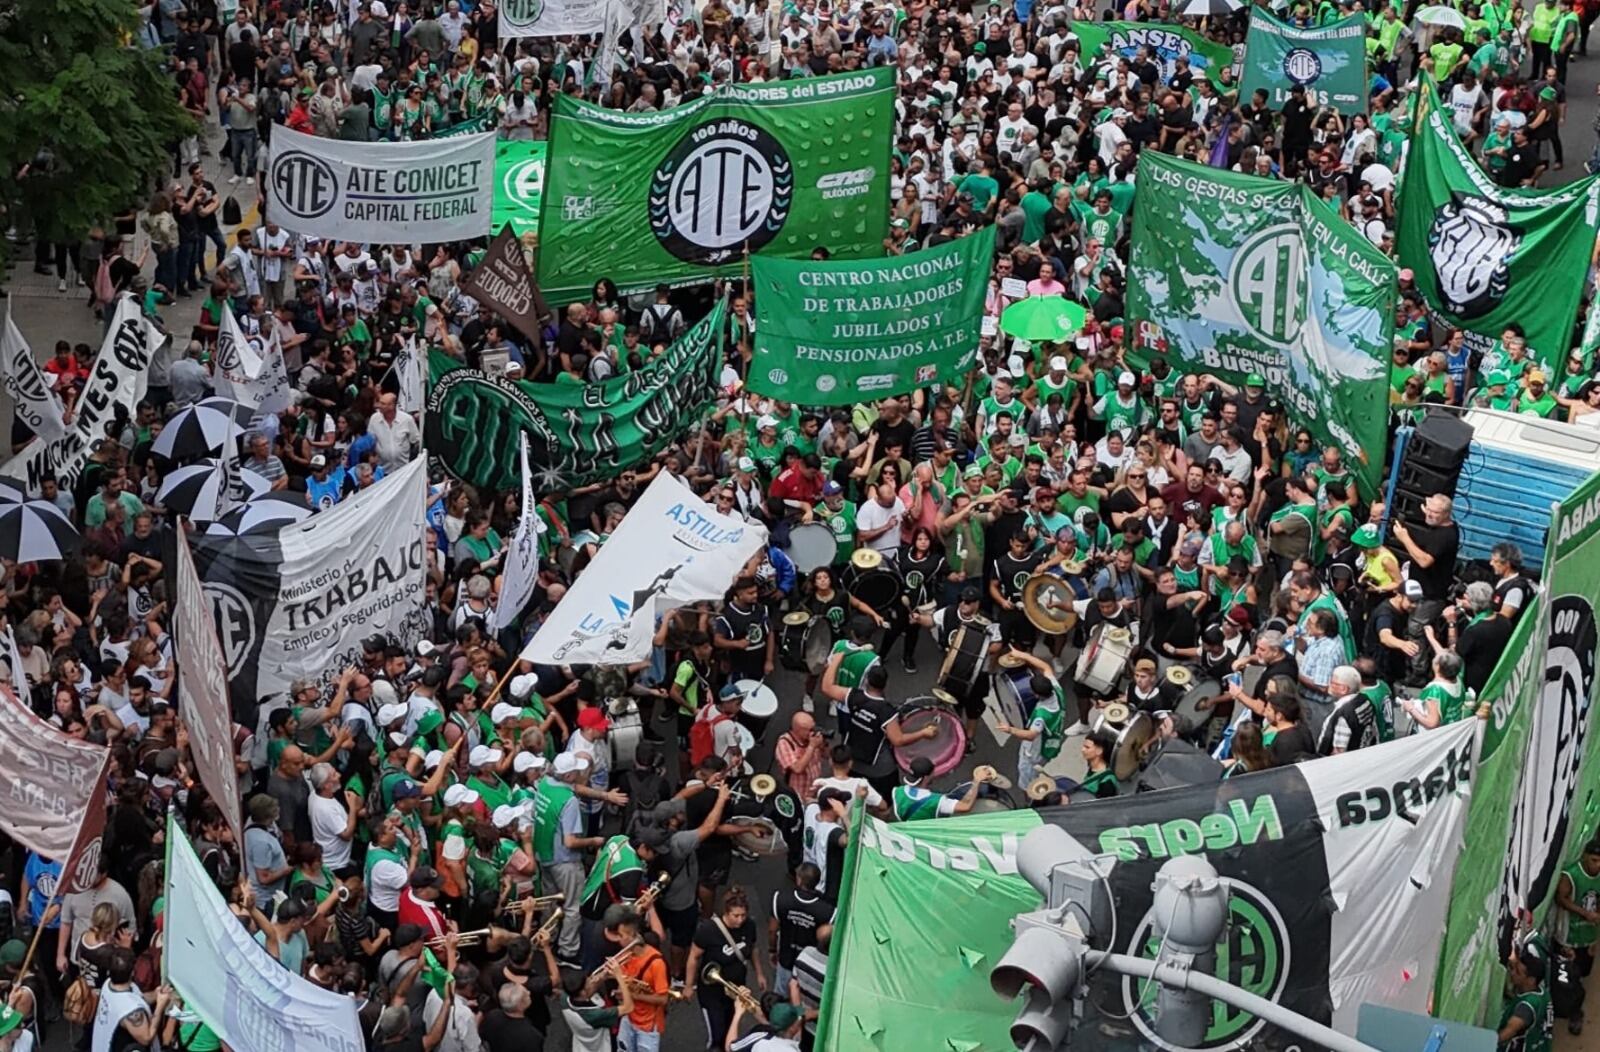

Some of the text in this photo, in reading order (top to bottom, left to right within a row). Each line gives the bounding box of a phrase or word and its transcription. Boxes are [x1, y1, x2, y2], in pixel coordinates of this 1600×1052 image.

[1112, 29, 1192, 57] ANSES
[792, 85, 815, 98] del
[818, 75, 876, 95] ESTADO
[1275, 87, 1329, 105] LAS
[691, 120, 759, 143] 100 AÑOS
[276, 157, 331, 213] ATE
[346, 166, 388, 194] ATE
[393, 160, 482, 194] CONICET
[676, 147, 762, 236] ATE
[821, 184, 870, 200] autónoma
[344, 196, 478, 222] CAPITAL FEDERAL
[1184, 176, 1249, 206] GESTAS
[1250, 192, 1276, 210] SE
[1312, 221, 1333, 245] EN
[1330, 235, 1347, 260] LA
[799, 251, 964, 287] CENTRO NACIONAL
[803, 279, 965, 313] DE TRABAJADORES
[832, 311, 945, 338] JUBILADOS Y
[114, 318, 148, 372] ATE
[796, 328, 969, 363] PENSIONADOS A.T.E.
[1226, 343, 1288, 366] Provincia
[1202, 347, 1290, 386] Buenos
[500, 378, 540, 415] SERVICIOS
[281, 567, 341, 601] Ministerio
[283, 538, 423, 632] TRABAJO
[283, 628, 330, 652] Empleo
[341, 592, 404, 625] Seguridad
